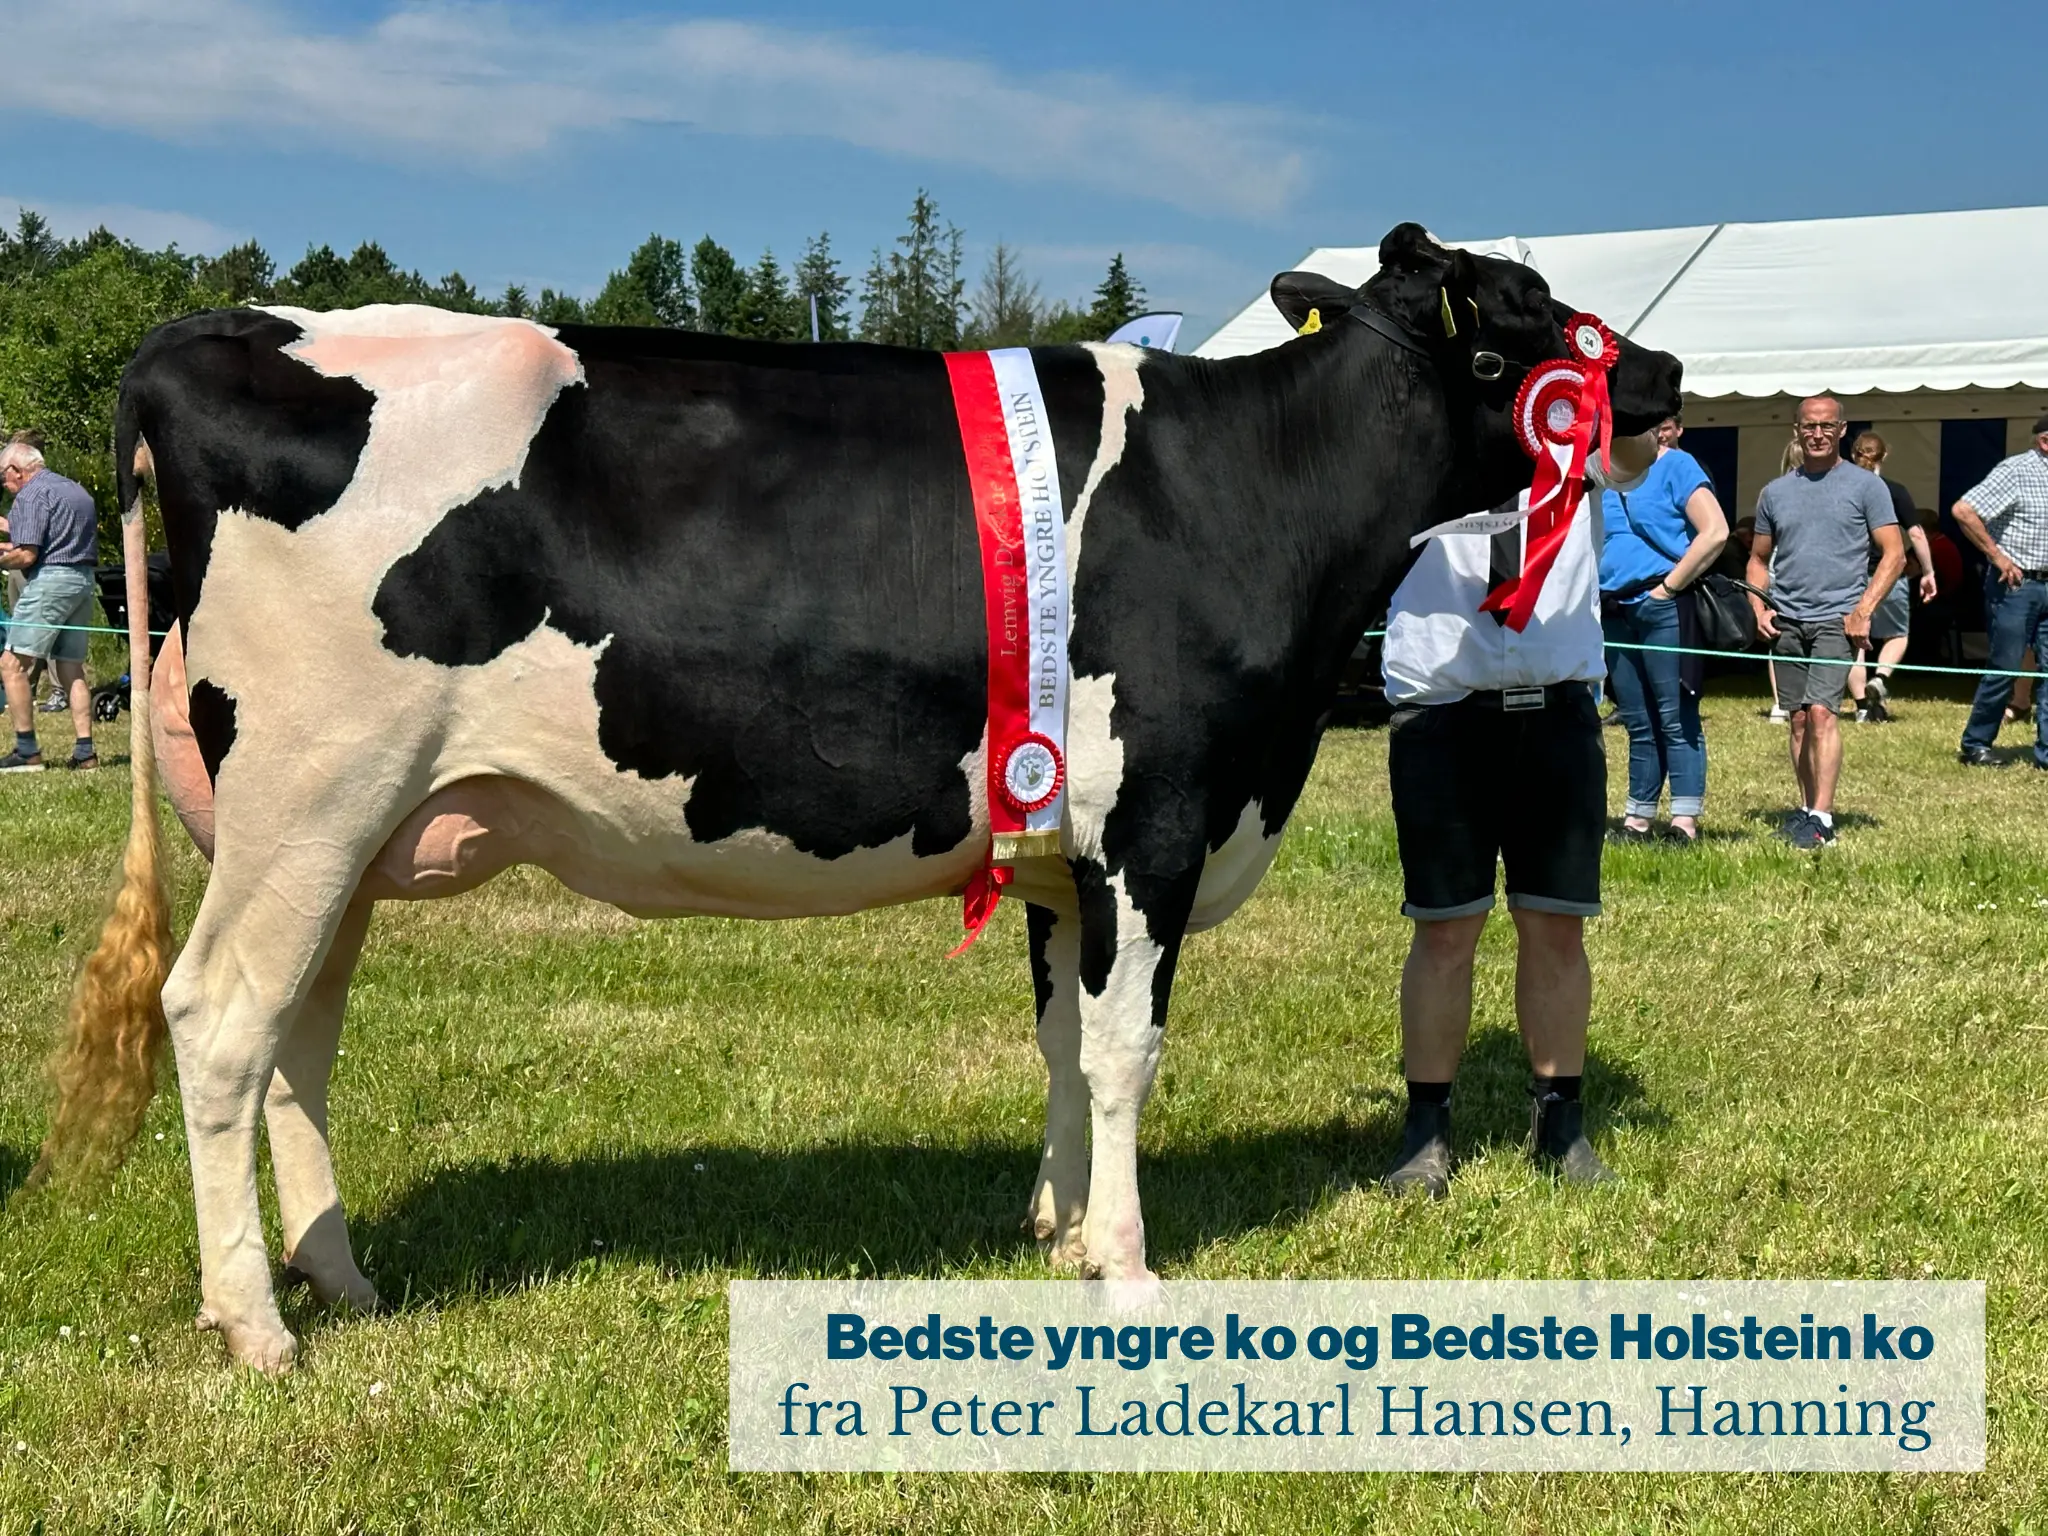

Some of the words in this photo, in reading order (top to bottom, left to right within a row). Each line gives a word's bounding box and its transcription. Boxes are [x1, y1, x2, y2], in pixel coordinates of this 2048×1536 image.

[1584, 335, 1594, 348] 24
[989, 481, 1014, 567] Dkue
[1035, 510, 1057, 600] YNGRE
[999, 574, 1021, 657] Lemvig
[1039, 606, 1057, 708] BEDSTE
